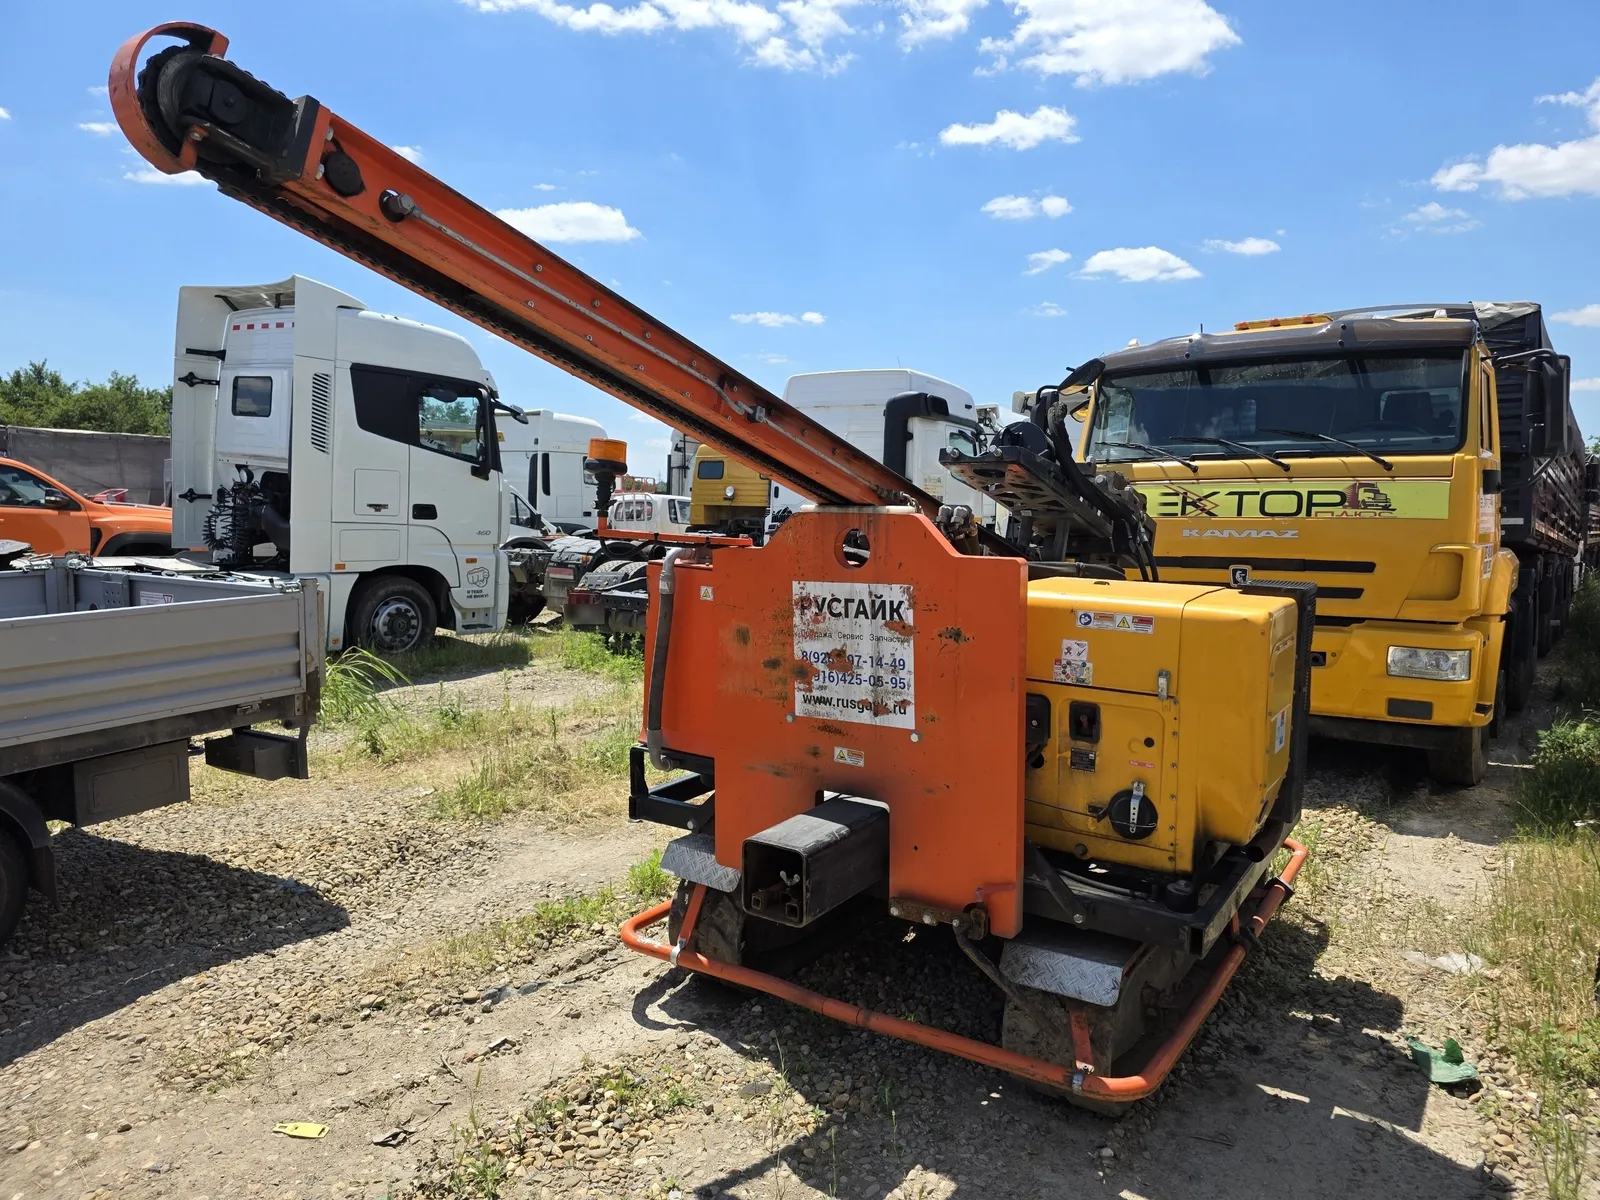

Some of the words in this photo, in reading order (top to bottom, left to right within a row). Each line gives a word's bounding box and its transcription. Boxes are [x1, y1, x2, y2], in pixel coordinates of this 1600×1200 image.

[1157, 489, 1347, 518] ЕКТОР
[1182, 528, 1300, 539] KAMAZ
[800, 594, 905, 621] РУСГАЙК
[837, 631, 864, 642] Сервис
[801, 650, 906, 671] 8(9297-14-49
[814, 670, 906, 690] 916)425-05-95
